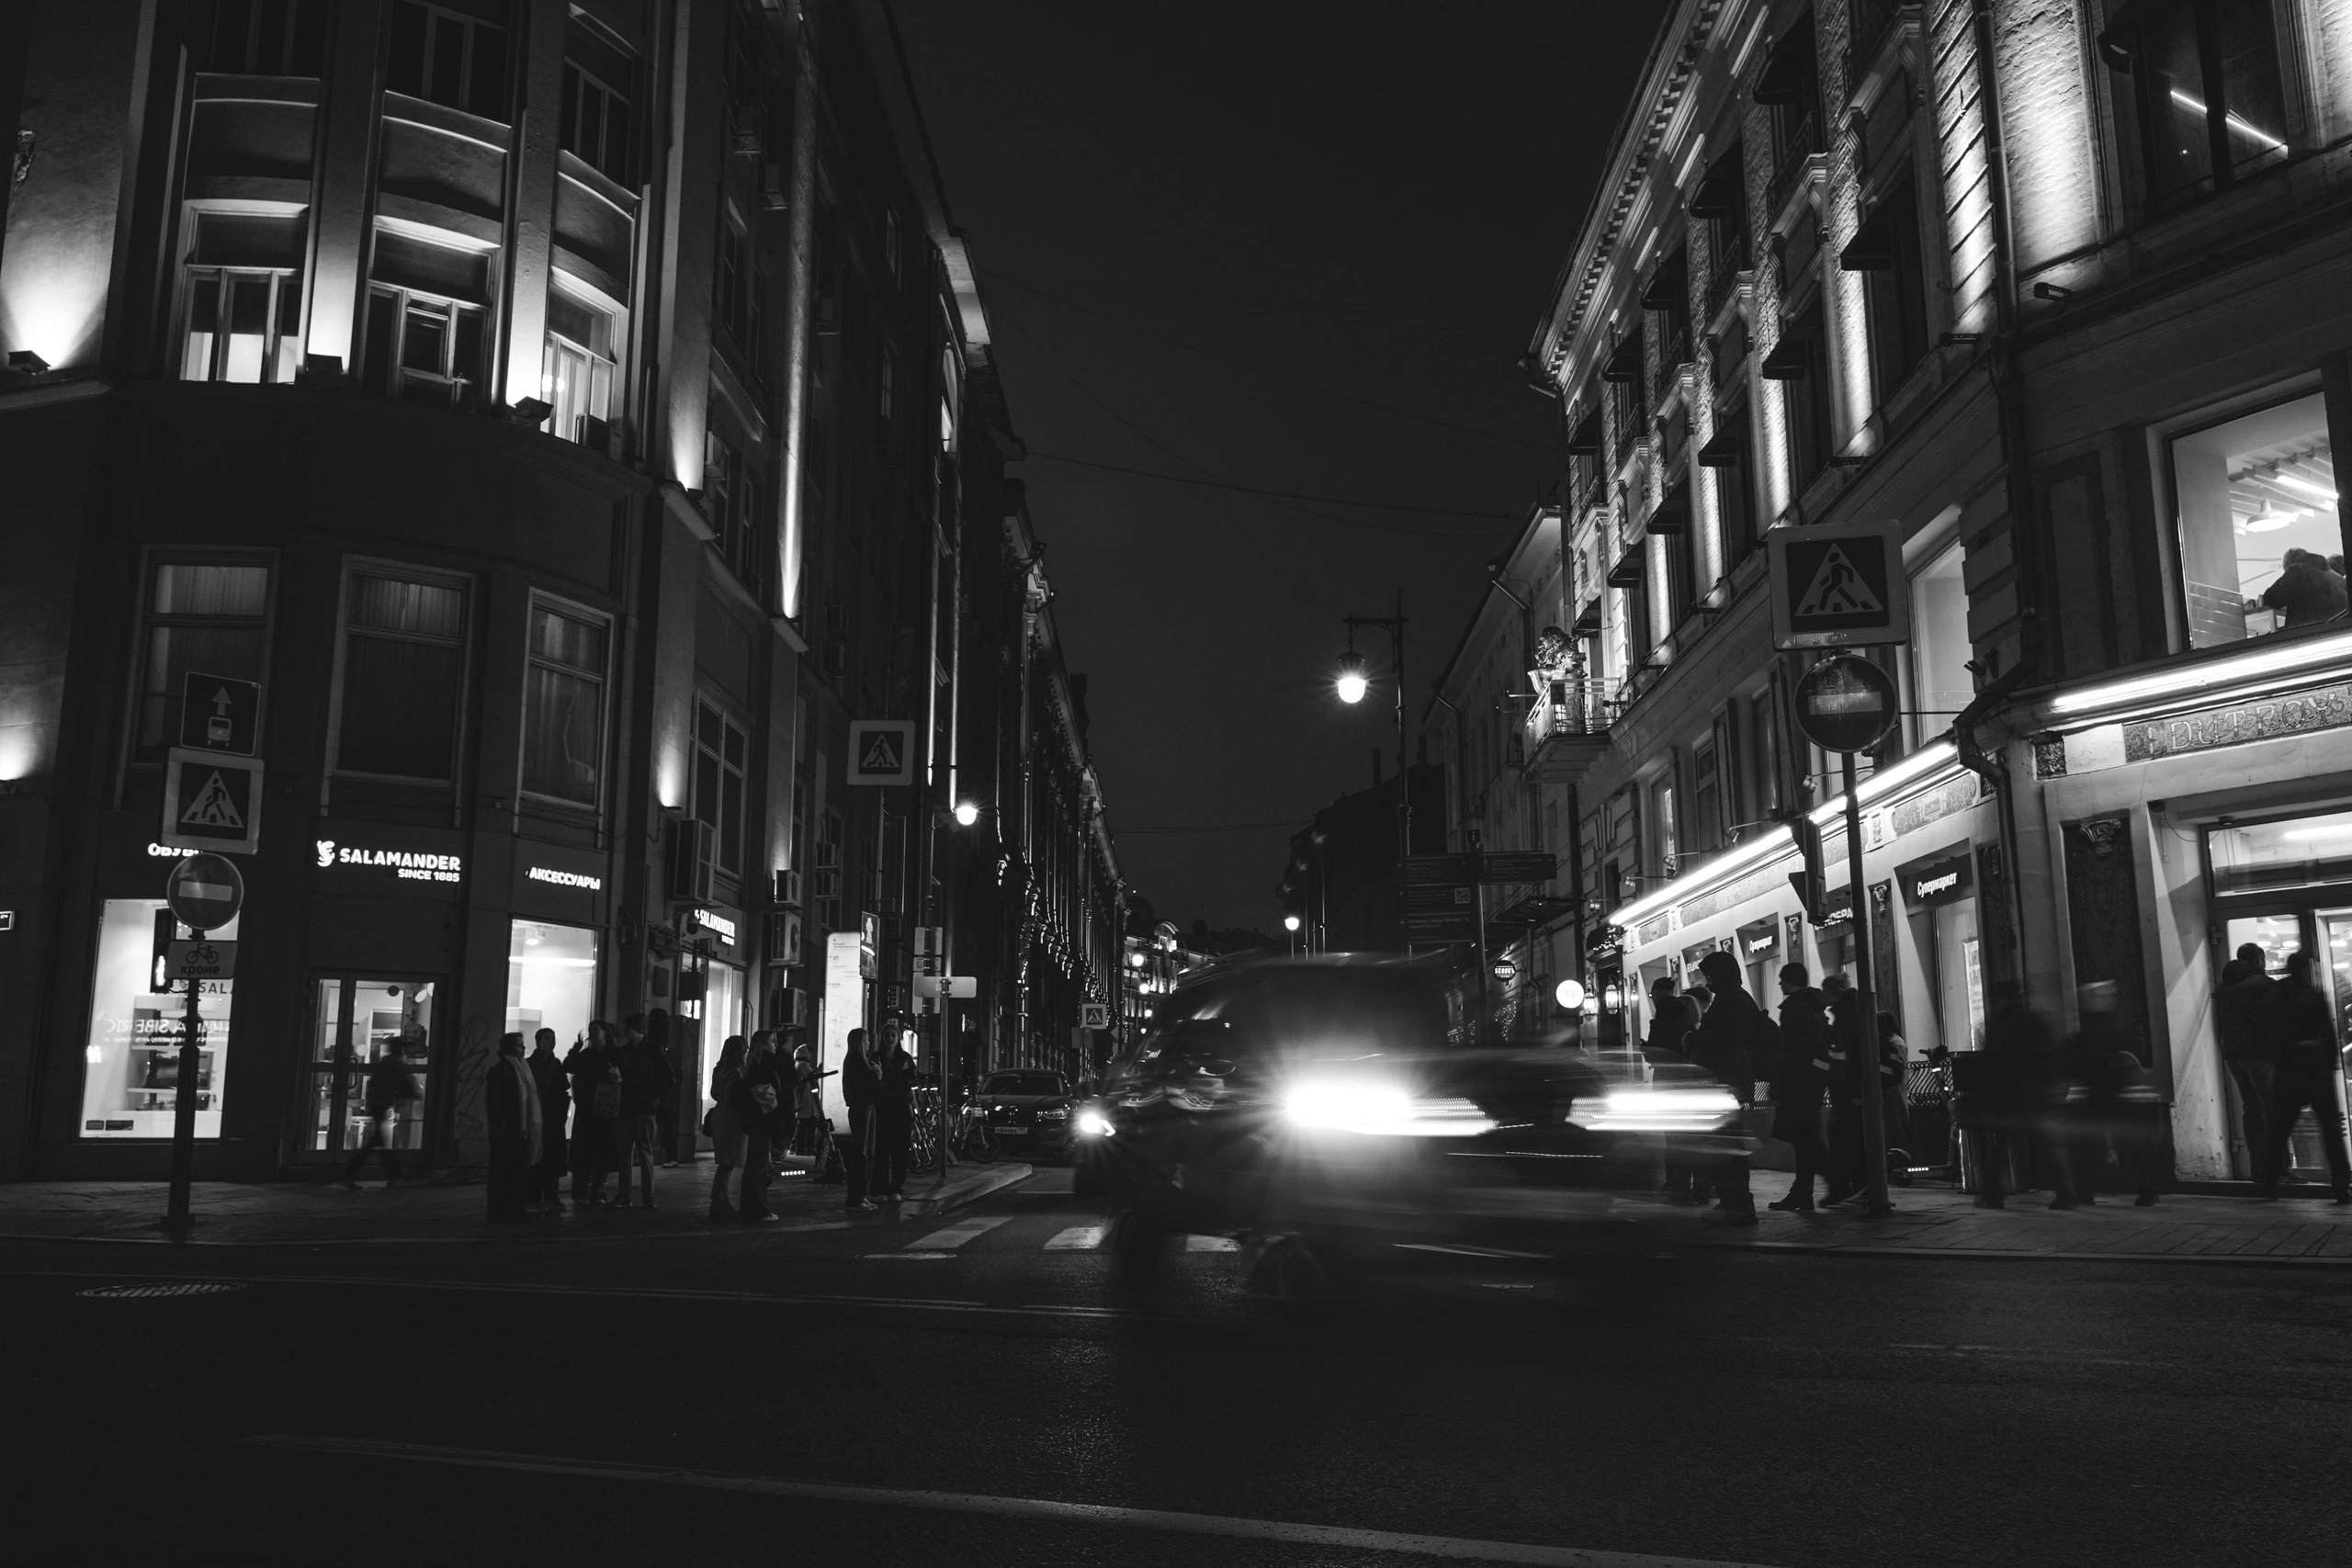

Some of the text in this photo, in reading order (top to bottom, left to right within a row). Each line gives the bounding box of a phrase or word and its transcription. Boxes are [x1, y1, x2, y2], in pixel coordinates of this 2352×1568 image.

[339, 848, 460, 871] SALAMANDER
[398, 868, 459, 882] SINCE 1885
[529, 867, 601, 890] АКСЕССУАРЫ
[1917, 873, 1957, 898] Супермаркет
[179, 965, 220, 977] кроме
[1687, 959, 1703, 973] EUR
[198, 982, 230, 994] SAL
